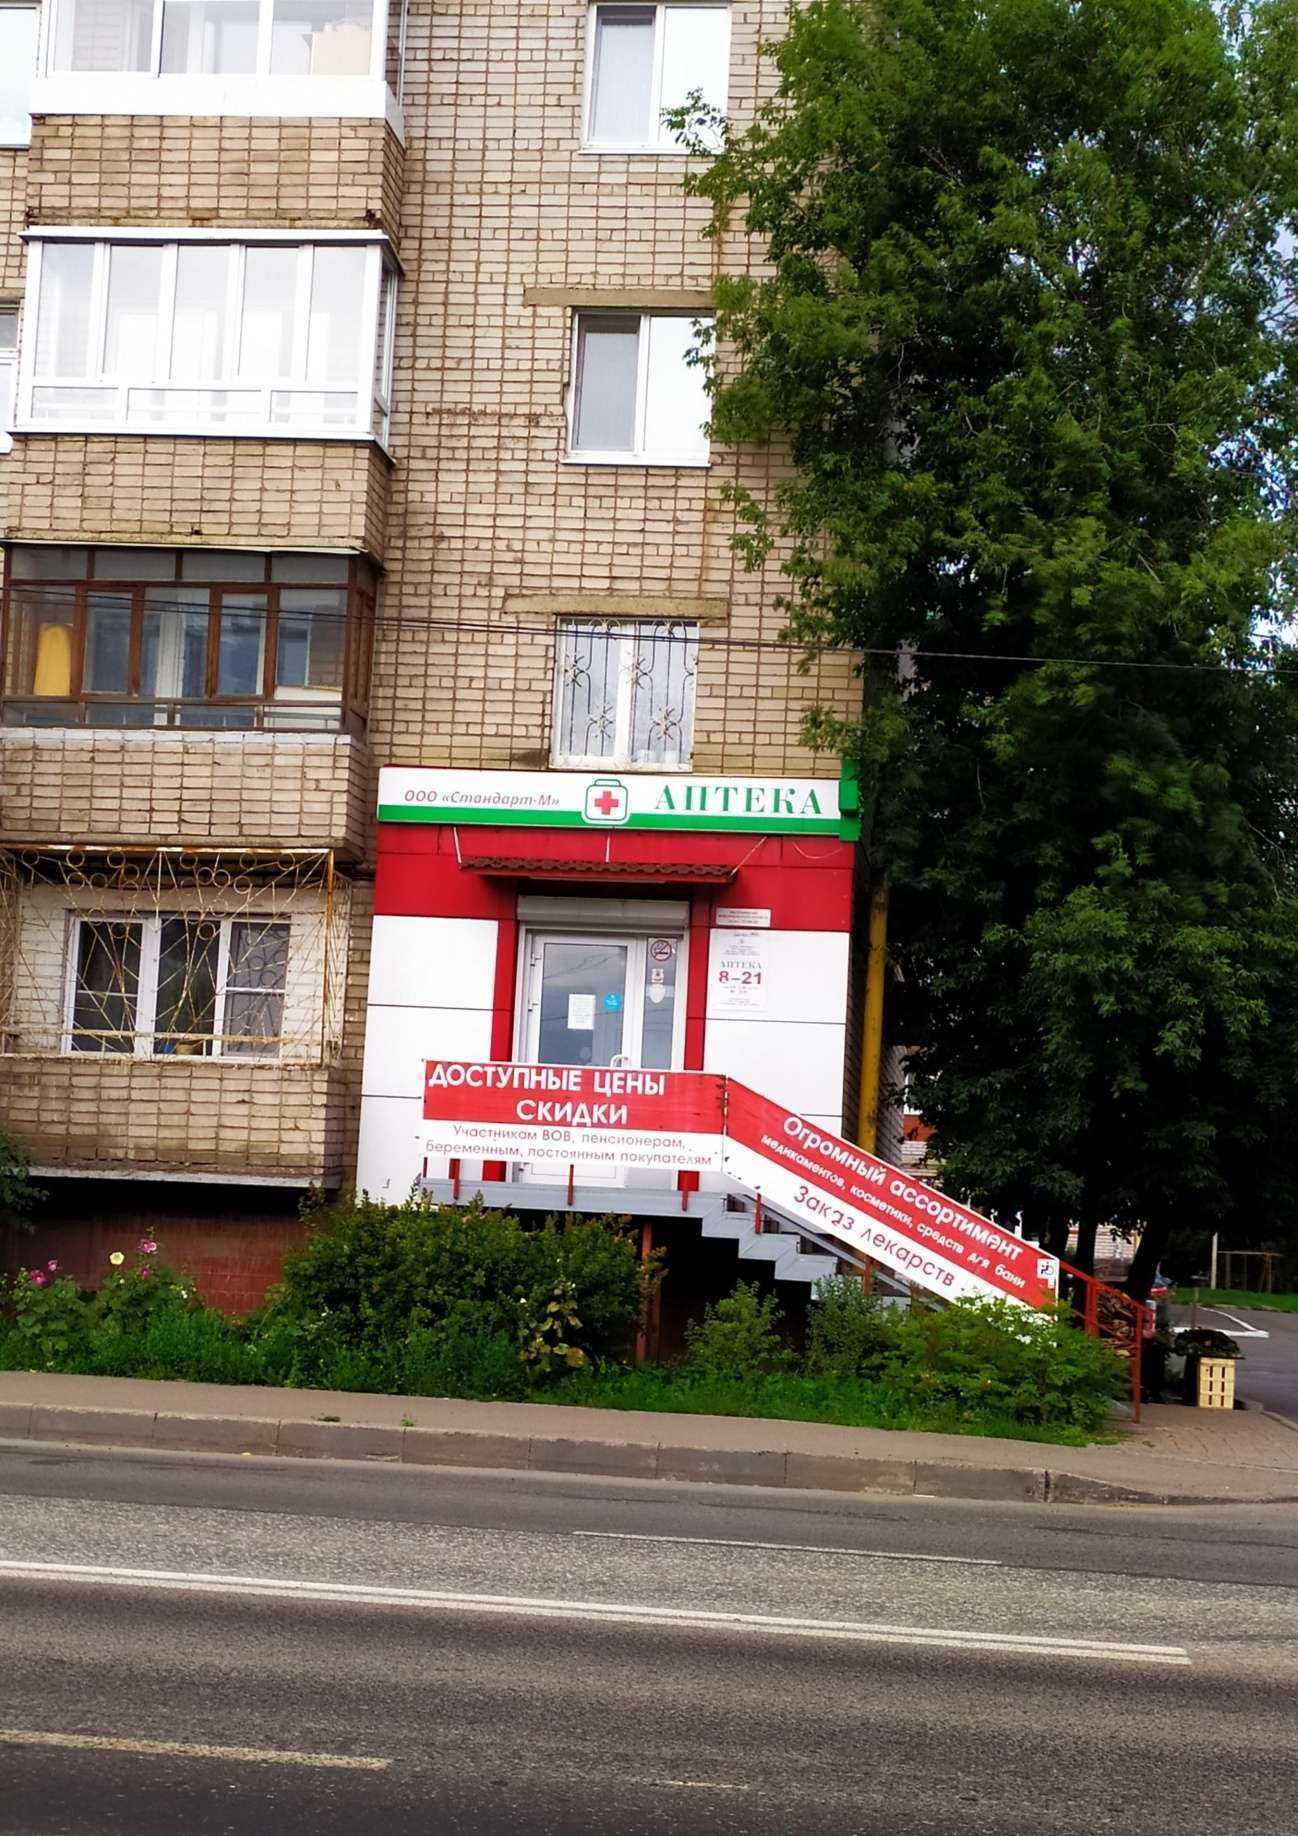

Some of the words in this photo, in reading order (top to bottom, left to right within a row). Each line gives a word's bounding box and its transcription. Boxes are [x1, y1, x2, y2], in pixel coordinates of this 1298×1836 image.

[655, 784, 824, 815] АПТЕКА
[428, 1064, 582, 1092] ДОСТУПНЫЕ
[593, 1072, 666, 1097] ЦЕНЫ
[516, 1099, 628, 1127] СКИДКИ
[426, 1140, 524, 1157] беременным,
[528, 1147, 615, 1161] постоянным
[620, 1152, 712, 1165] покупателям
[453, 1125, 538, 1140] Участникам
[542, 1129, 576, 1143] ВОВ,
[582, 1133, 686, 1149] пенсионерам,
[760, 1135, 846, 1190] медикаментов,
[851, 1184, 913, 1229] косметики,
[916, 1223, 965, 1253] средств
[783, 1117, 888, 1185] Огромный
[889, 1180, 1024, 1261] ассортимент
[793, 1186, 855, 1230] Заказ
[860, 1228, 955, 1286] лекарств
